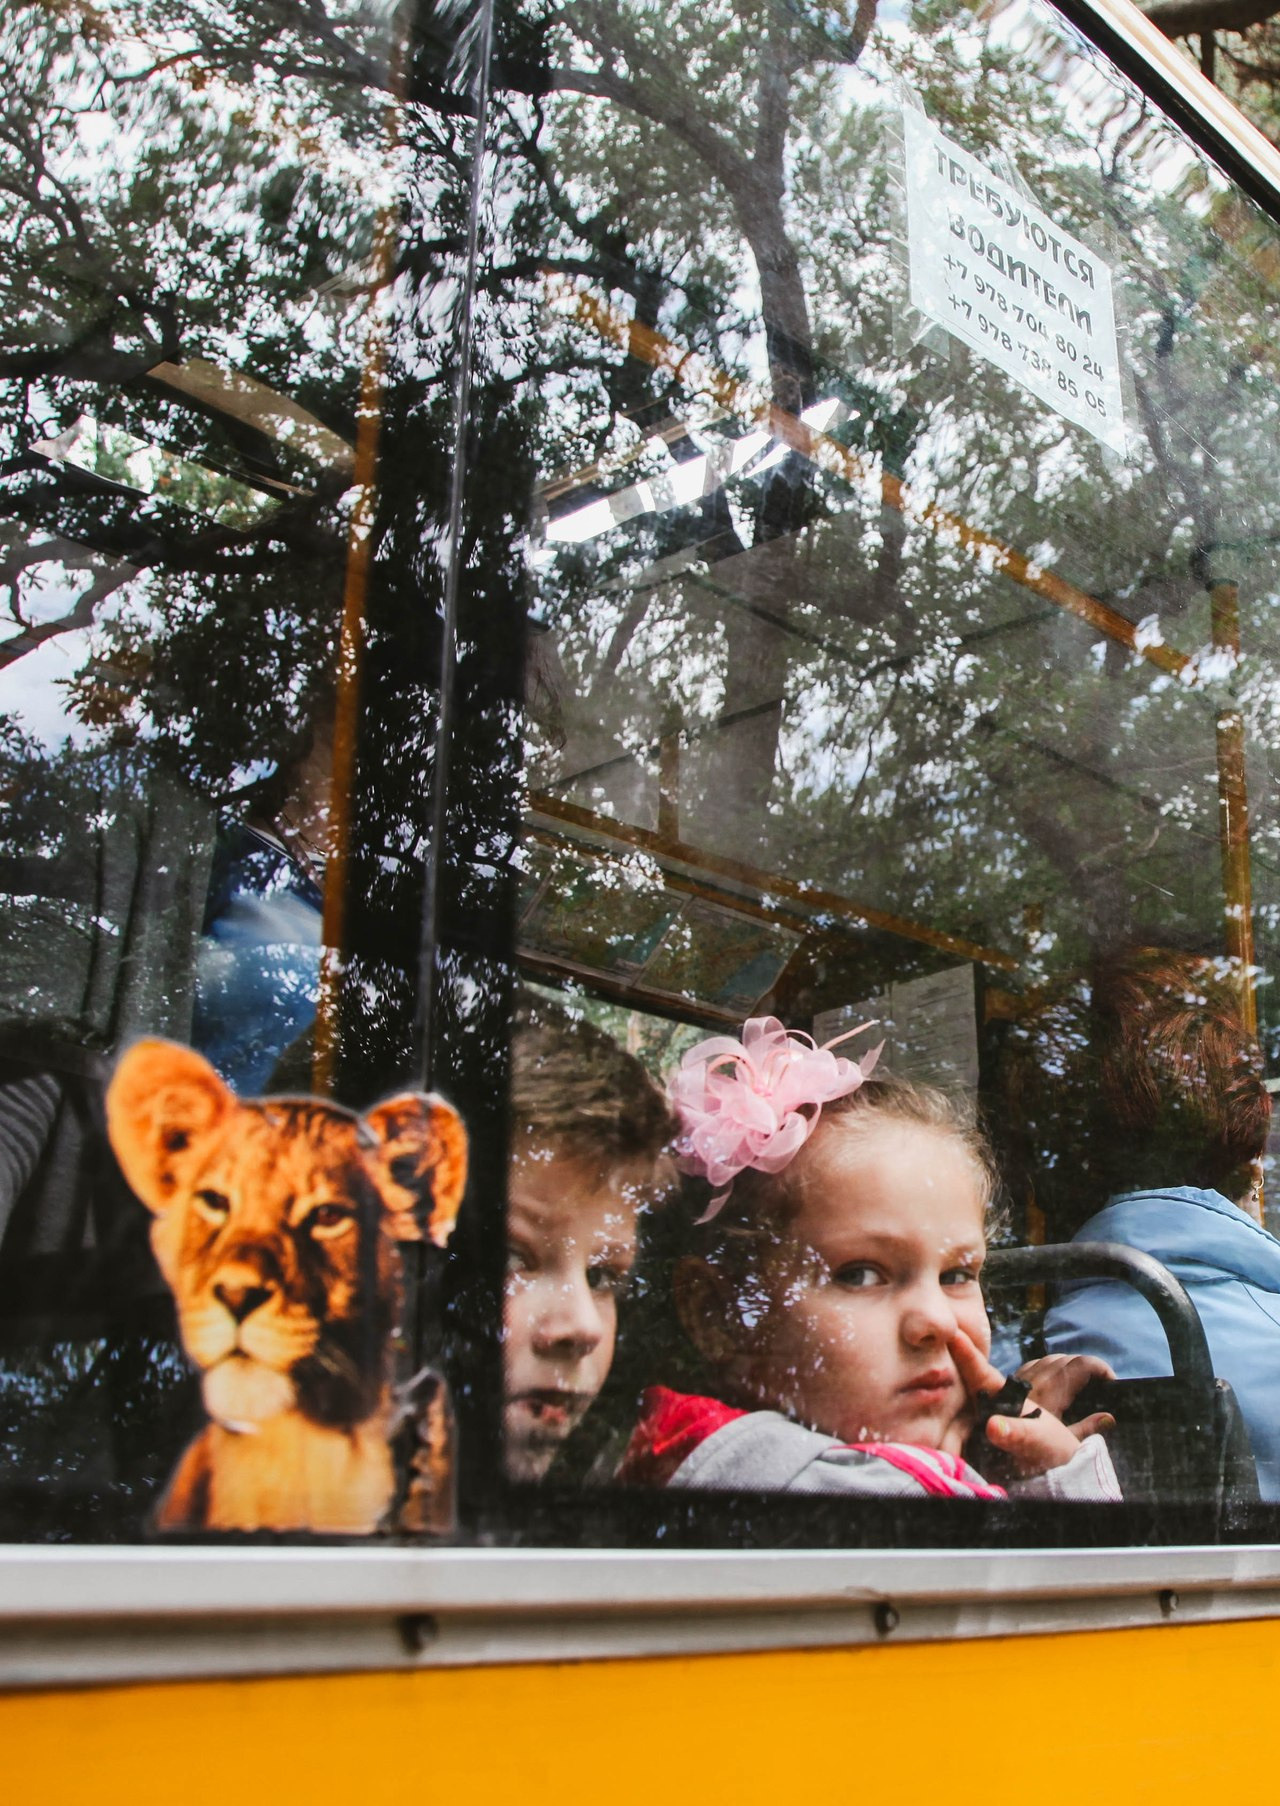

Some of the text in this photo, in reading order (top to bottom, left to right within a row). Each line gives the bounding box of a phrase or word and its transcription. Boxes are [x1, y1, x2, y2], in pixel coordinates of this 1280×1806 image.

[934, 144, 1095, 290] ТРЕБУЮТСЯ
[947, 206, 1093, 337] ВОДИТЕЛИ
[943, 254, 1104, 381] +7 978 704 80 24
[948, 294, 972, 320] +7
[978, 313, 1012, 352] 978
[1057, 371, 1078, 398] 85
[1085, 390, 1107, 417] 05
